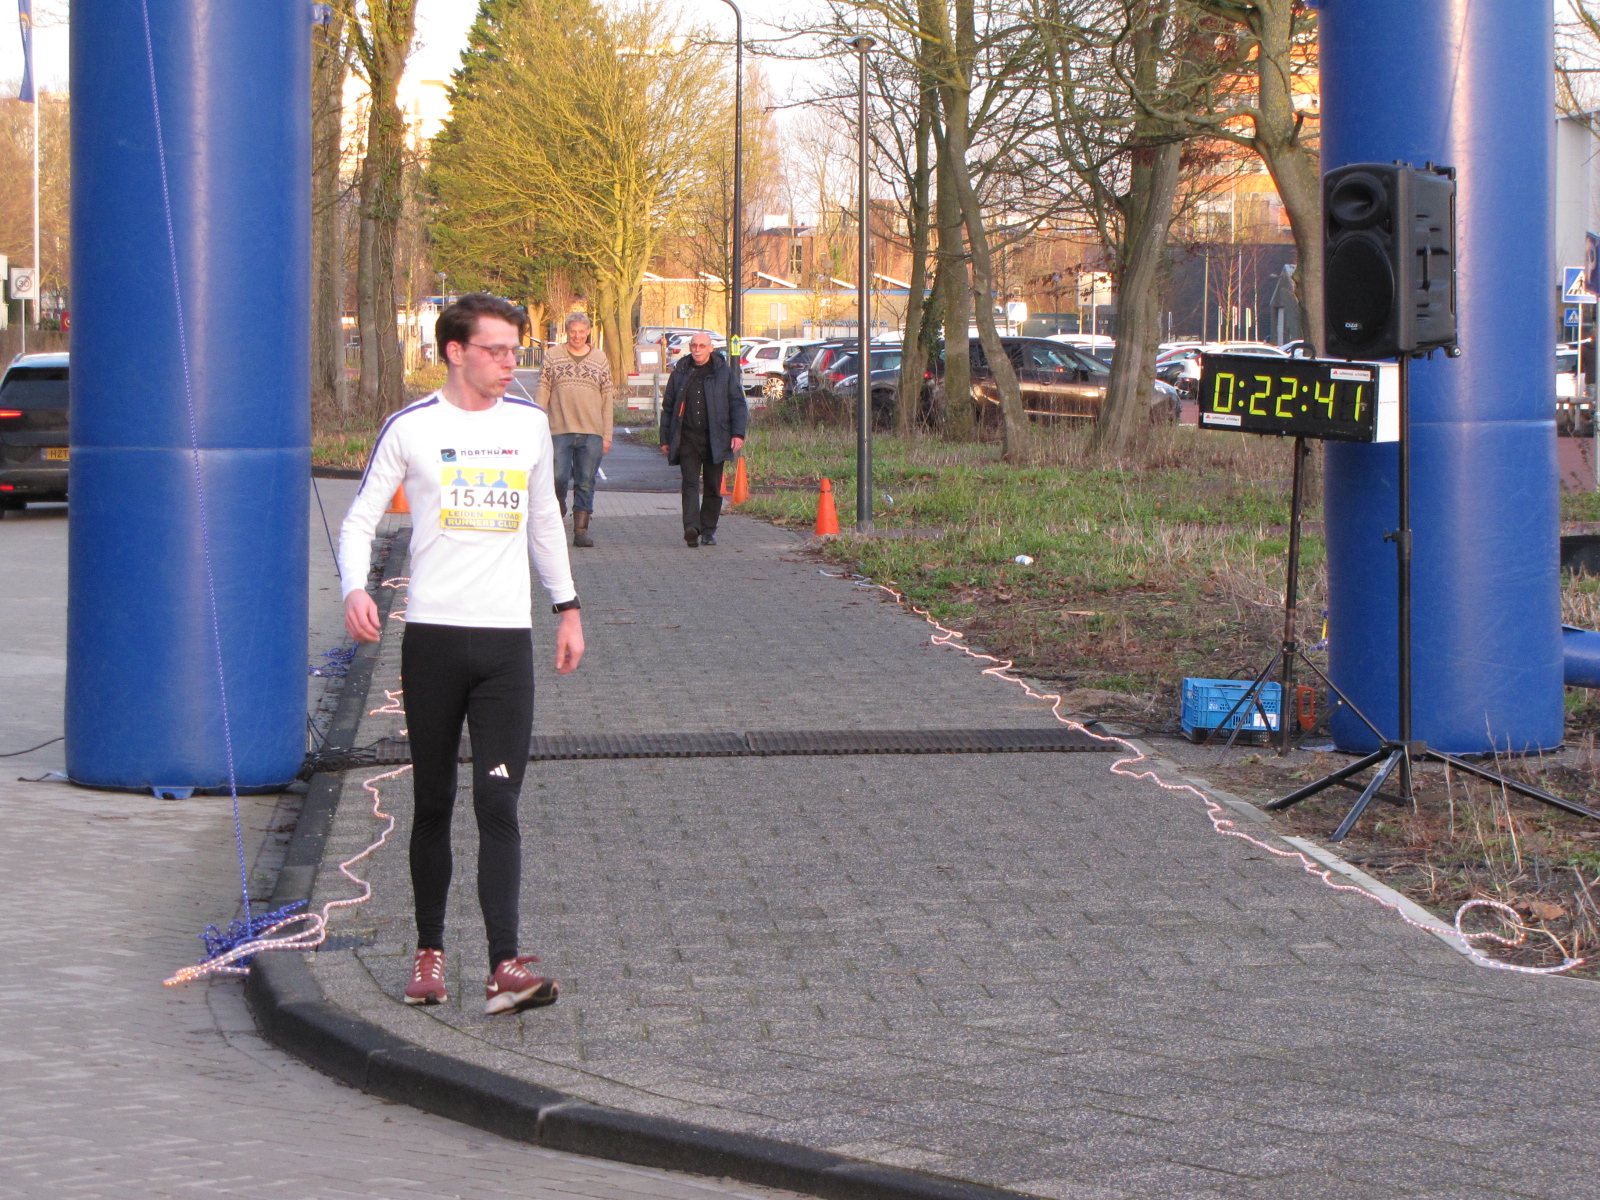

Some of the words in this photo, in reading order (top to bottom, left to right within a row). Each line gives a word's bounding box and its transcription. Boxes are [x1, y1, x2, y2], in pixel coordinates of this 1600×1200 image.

[18, 280, 30, 288] 30
[1213, 372, 1362, 422] 0:22:41
[460, 449, 520, 457] NORTHWAVE
[450, 488, 520, 510] 15.449
[448, 510, 483, 518] LEIDEN
[498, 512, 520, 520] ROAD
[447, 518, 496, 527] RUNNERS
[497, 520, 519, 529] CLUB
